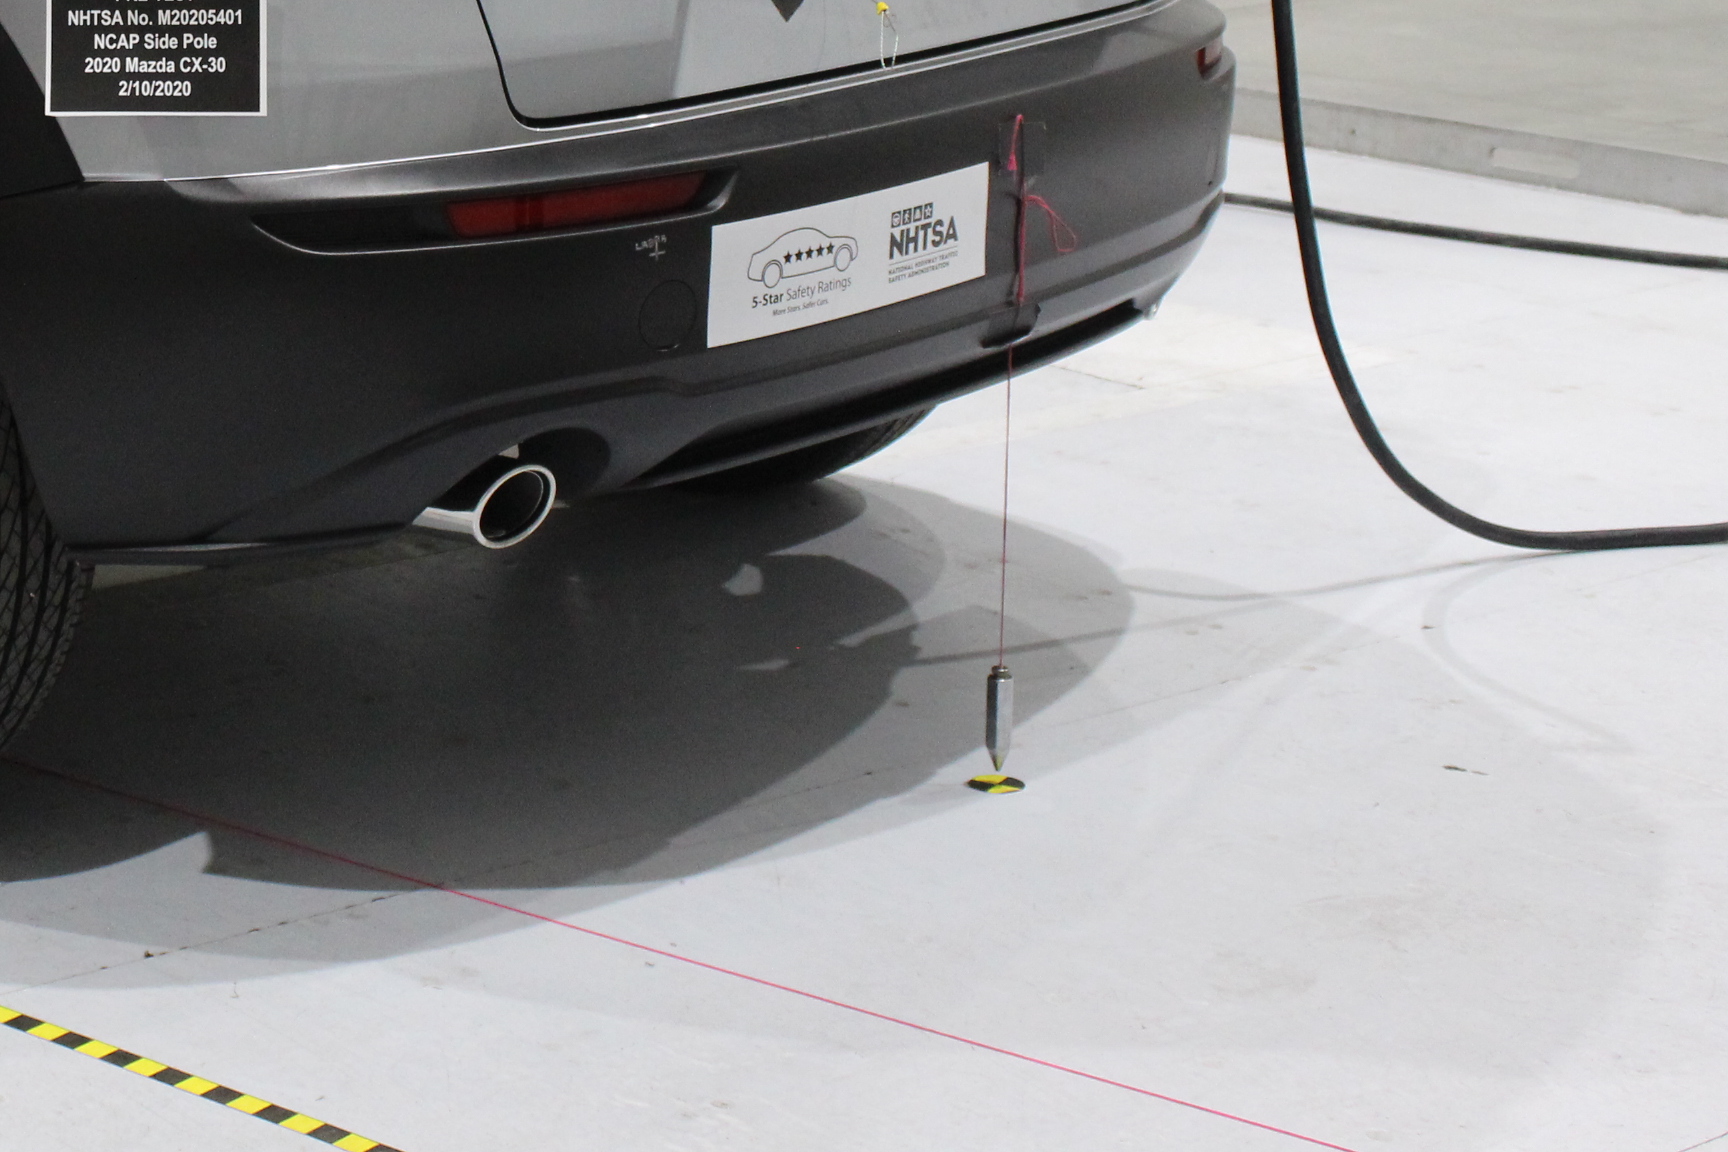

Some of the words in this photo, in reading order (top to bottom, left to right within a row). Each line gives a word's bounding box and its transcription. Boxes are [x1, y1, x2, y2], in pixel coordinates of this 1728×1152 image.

[67, 10, 123, 26] NHTSA
[127, 10, 153, 26] No.
[158, 9, 242, 26] M20205401
[94, 33, 140, 50] NCAP
[144, 33, 179, 49] Side
[183, 33, 218, 49] Pole
[84, 57, 121, 73] 2020
[125, 57, 175, 73] Mazda
[179, 57, 226, 73] CX-30
[118, 80, 192, 97] 2/10/2020
[889, 215, 958, 260] NHTSA
[751, 293, 784, 309] 5-Star
[786, 285, 816, 302] Safety
[817, 277, 852, 292] Ratings
